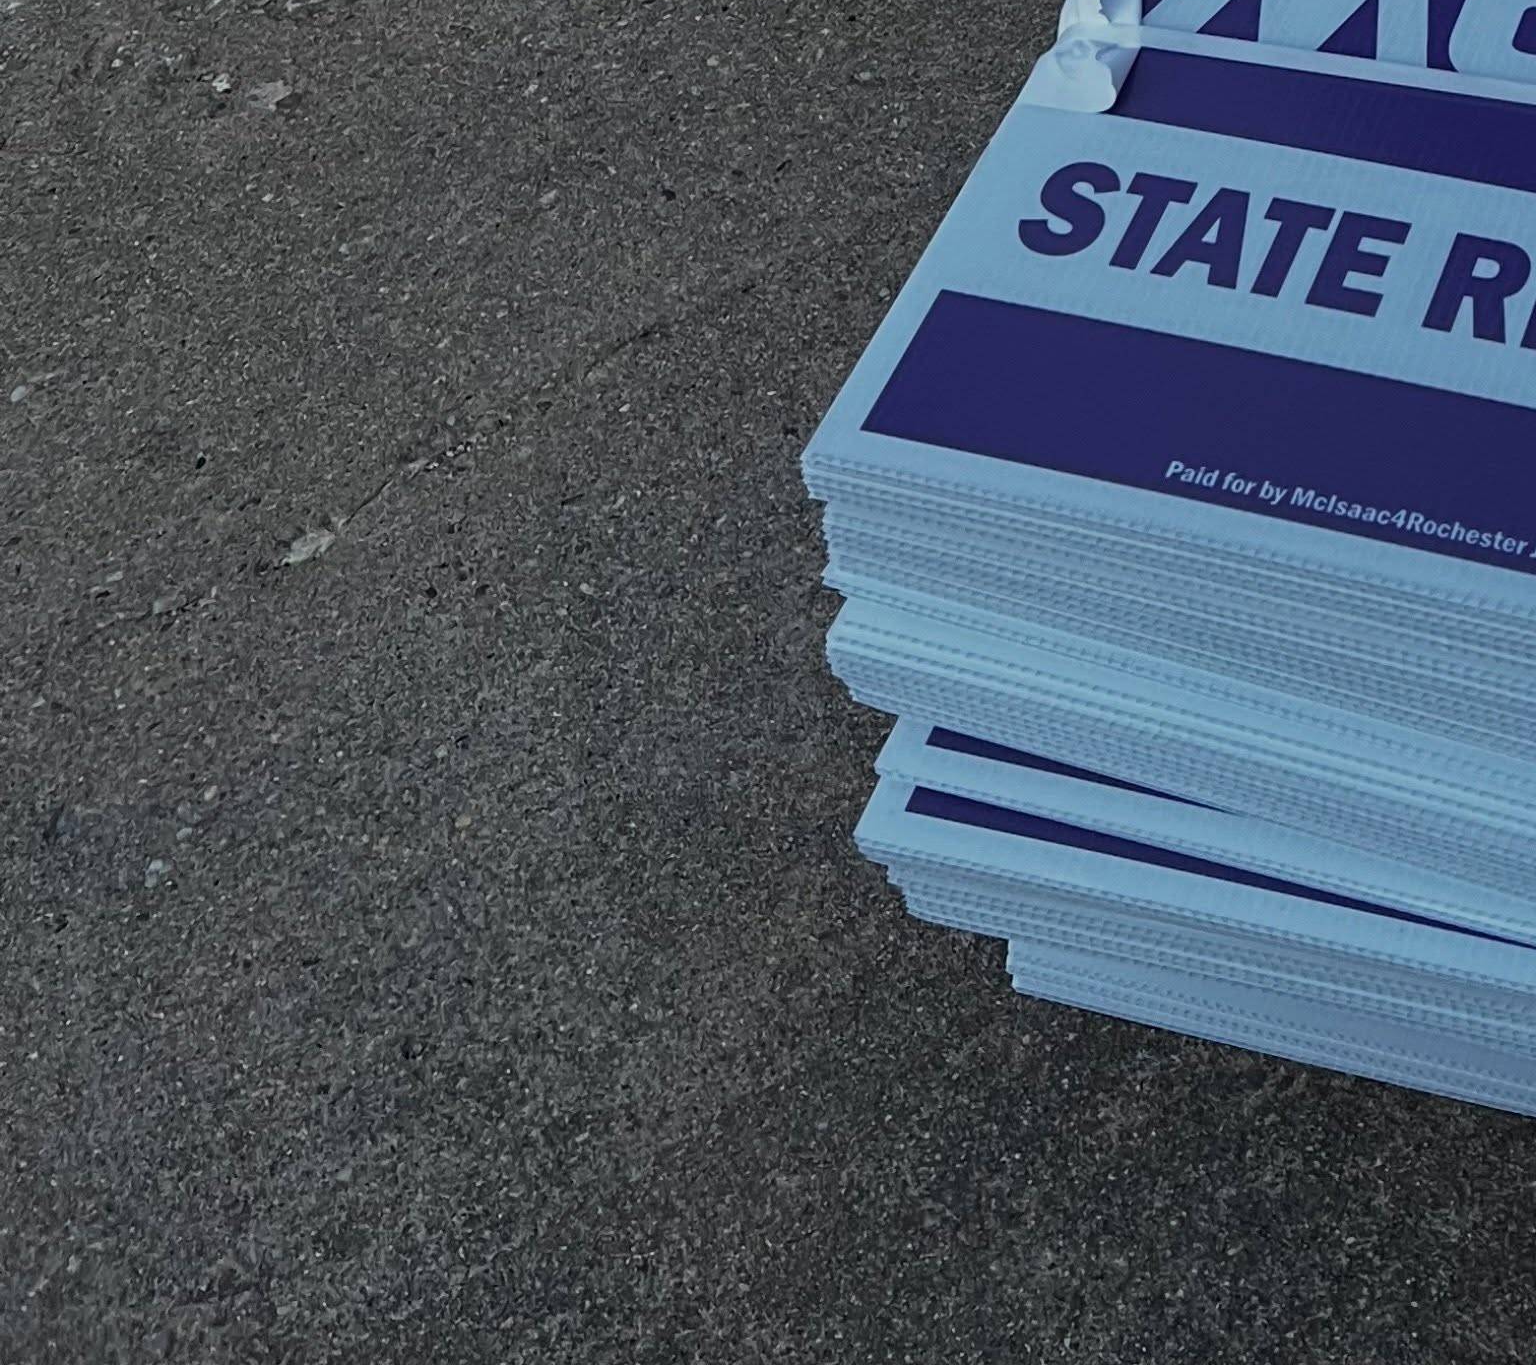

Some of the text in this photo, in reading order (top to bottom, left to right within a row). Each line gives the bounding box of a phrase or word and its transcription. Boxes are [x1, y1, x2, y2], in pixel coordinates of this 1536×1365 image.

[1017, 161, 1413, 318] STATE
[1164, 459, 1217, 489] Paid
[1220, 471, 1258, 496] for
[1258, 479, 1287, 506] by
[1289, 485, 1529, 557] McIsaac4Rochester
